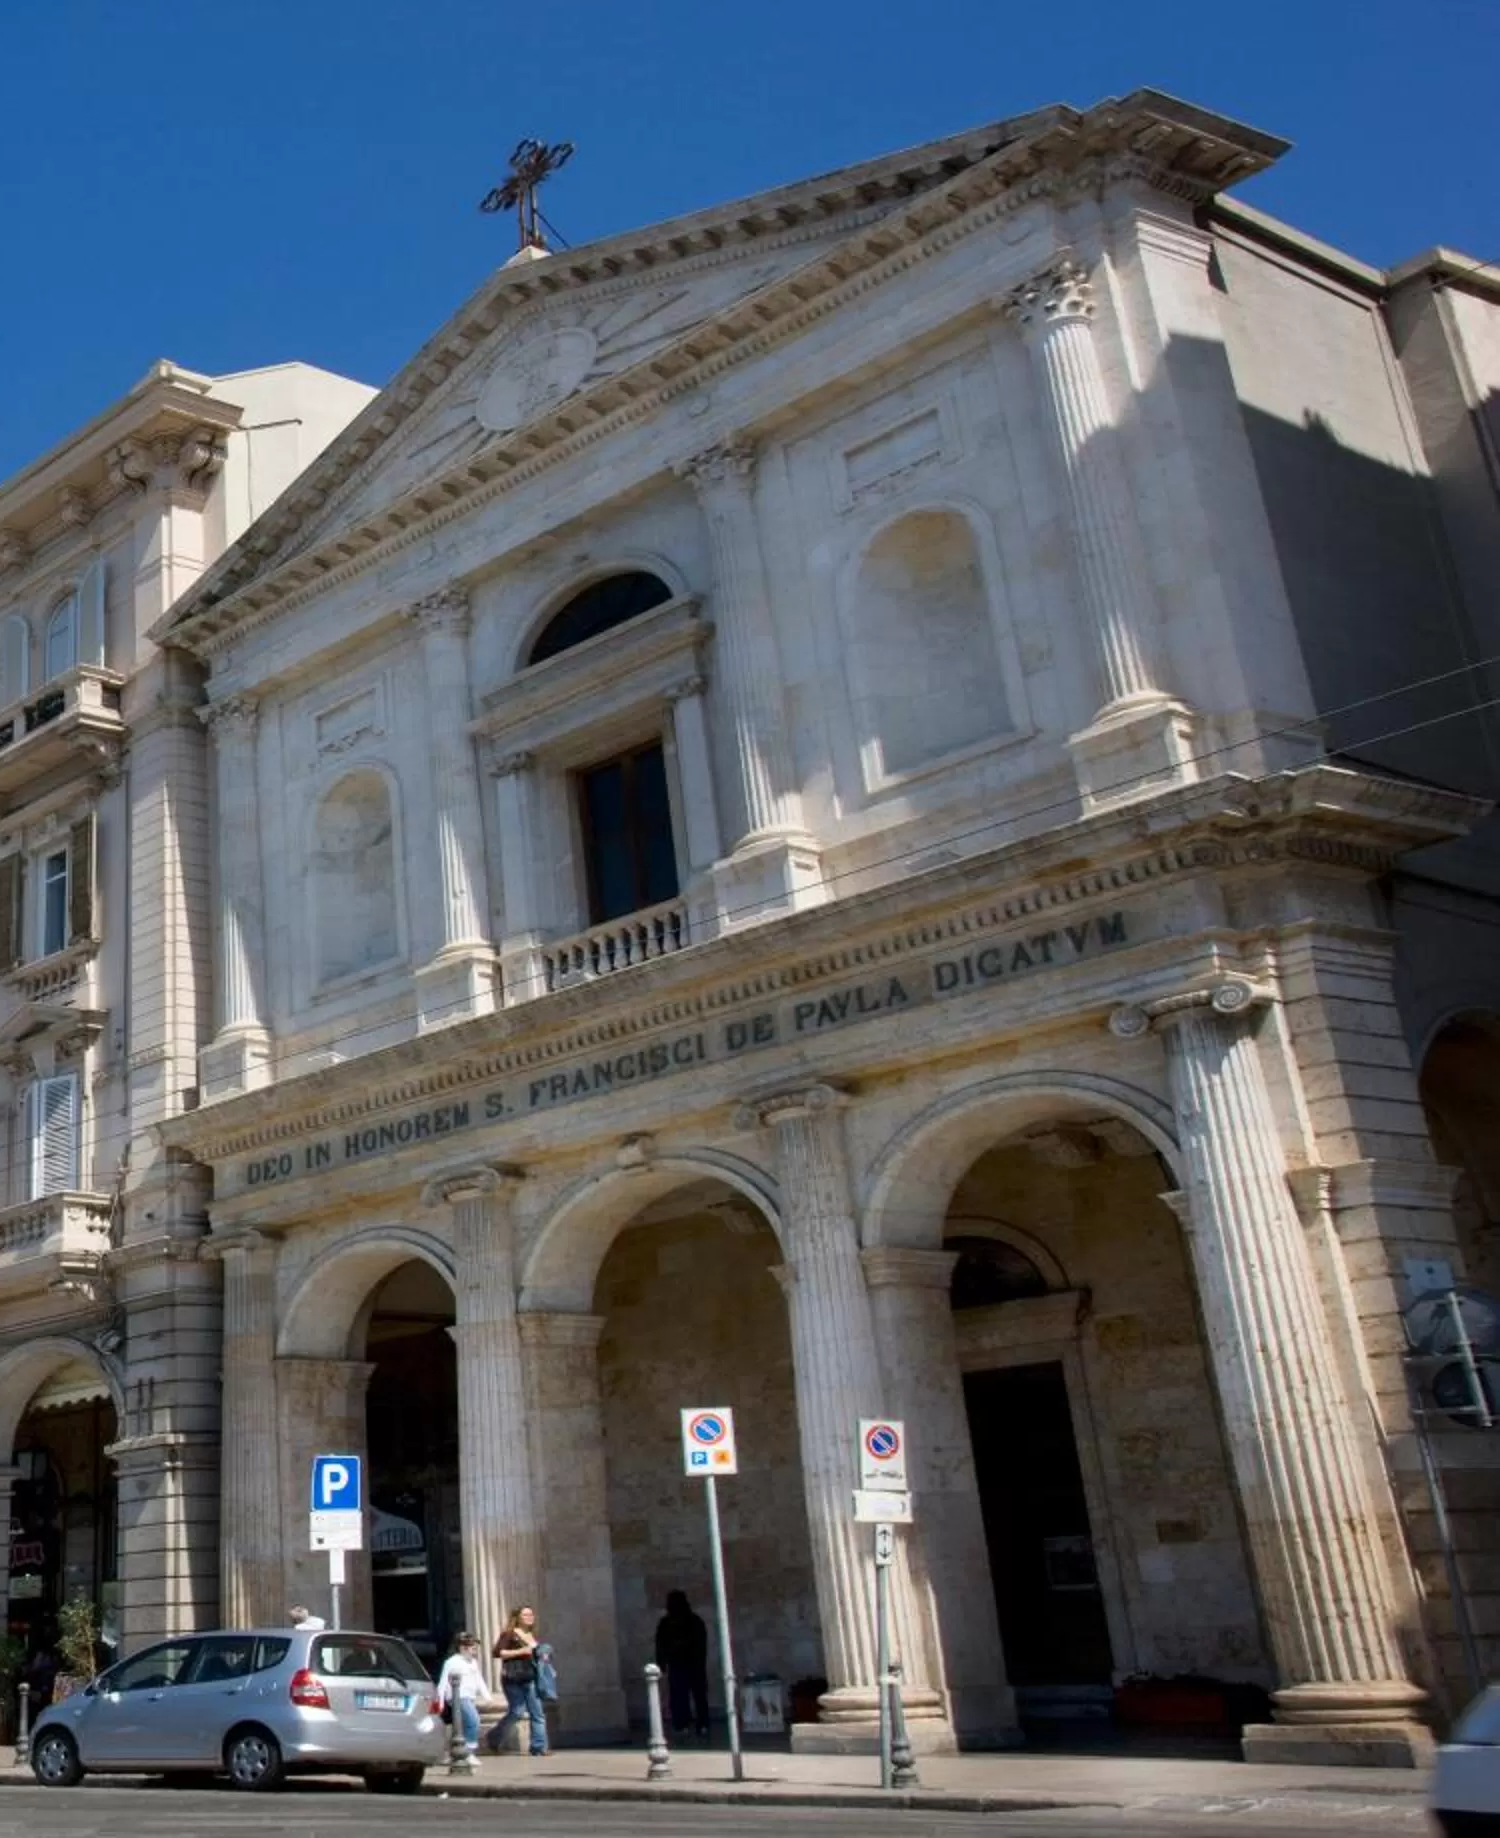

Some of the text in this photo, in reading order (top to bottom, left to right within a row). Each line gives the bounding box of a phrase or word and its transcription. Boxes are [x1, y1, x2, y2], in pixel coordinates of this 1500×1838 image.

[247, 1154, 293, 1185] DEO
[305, 1141, 332, 1169] IN
[345, 1101, 470, 1158] HONOREM
[485, 1092, 514, 1119] S.
[528, 1033, 706, 1107] FRANCISCI
[725, 1012, 774, 1051] DE
[933, 911, 1127, 992] DICATVM
[694, 1452, 704, 1464] P
[322, 1463, 349, 1504] P
